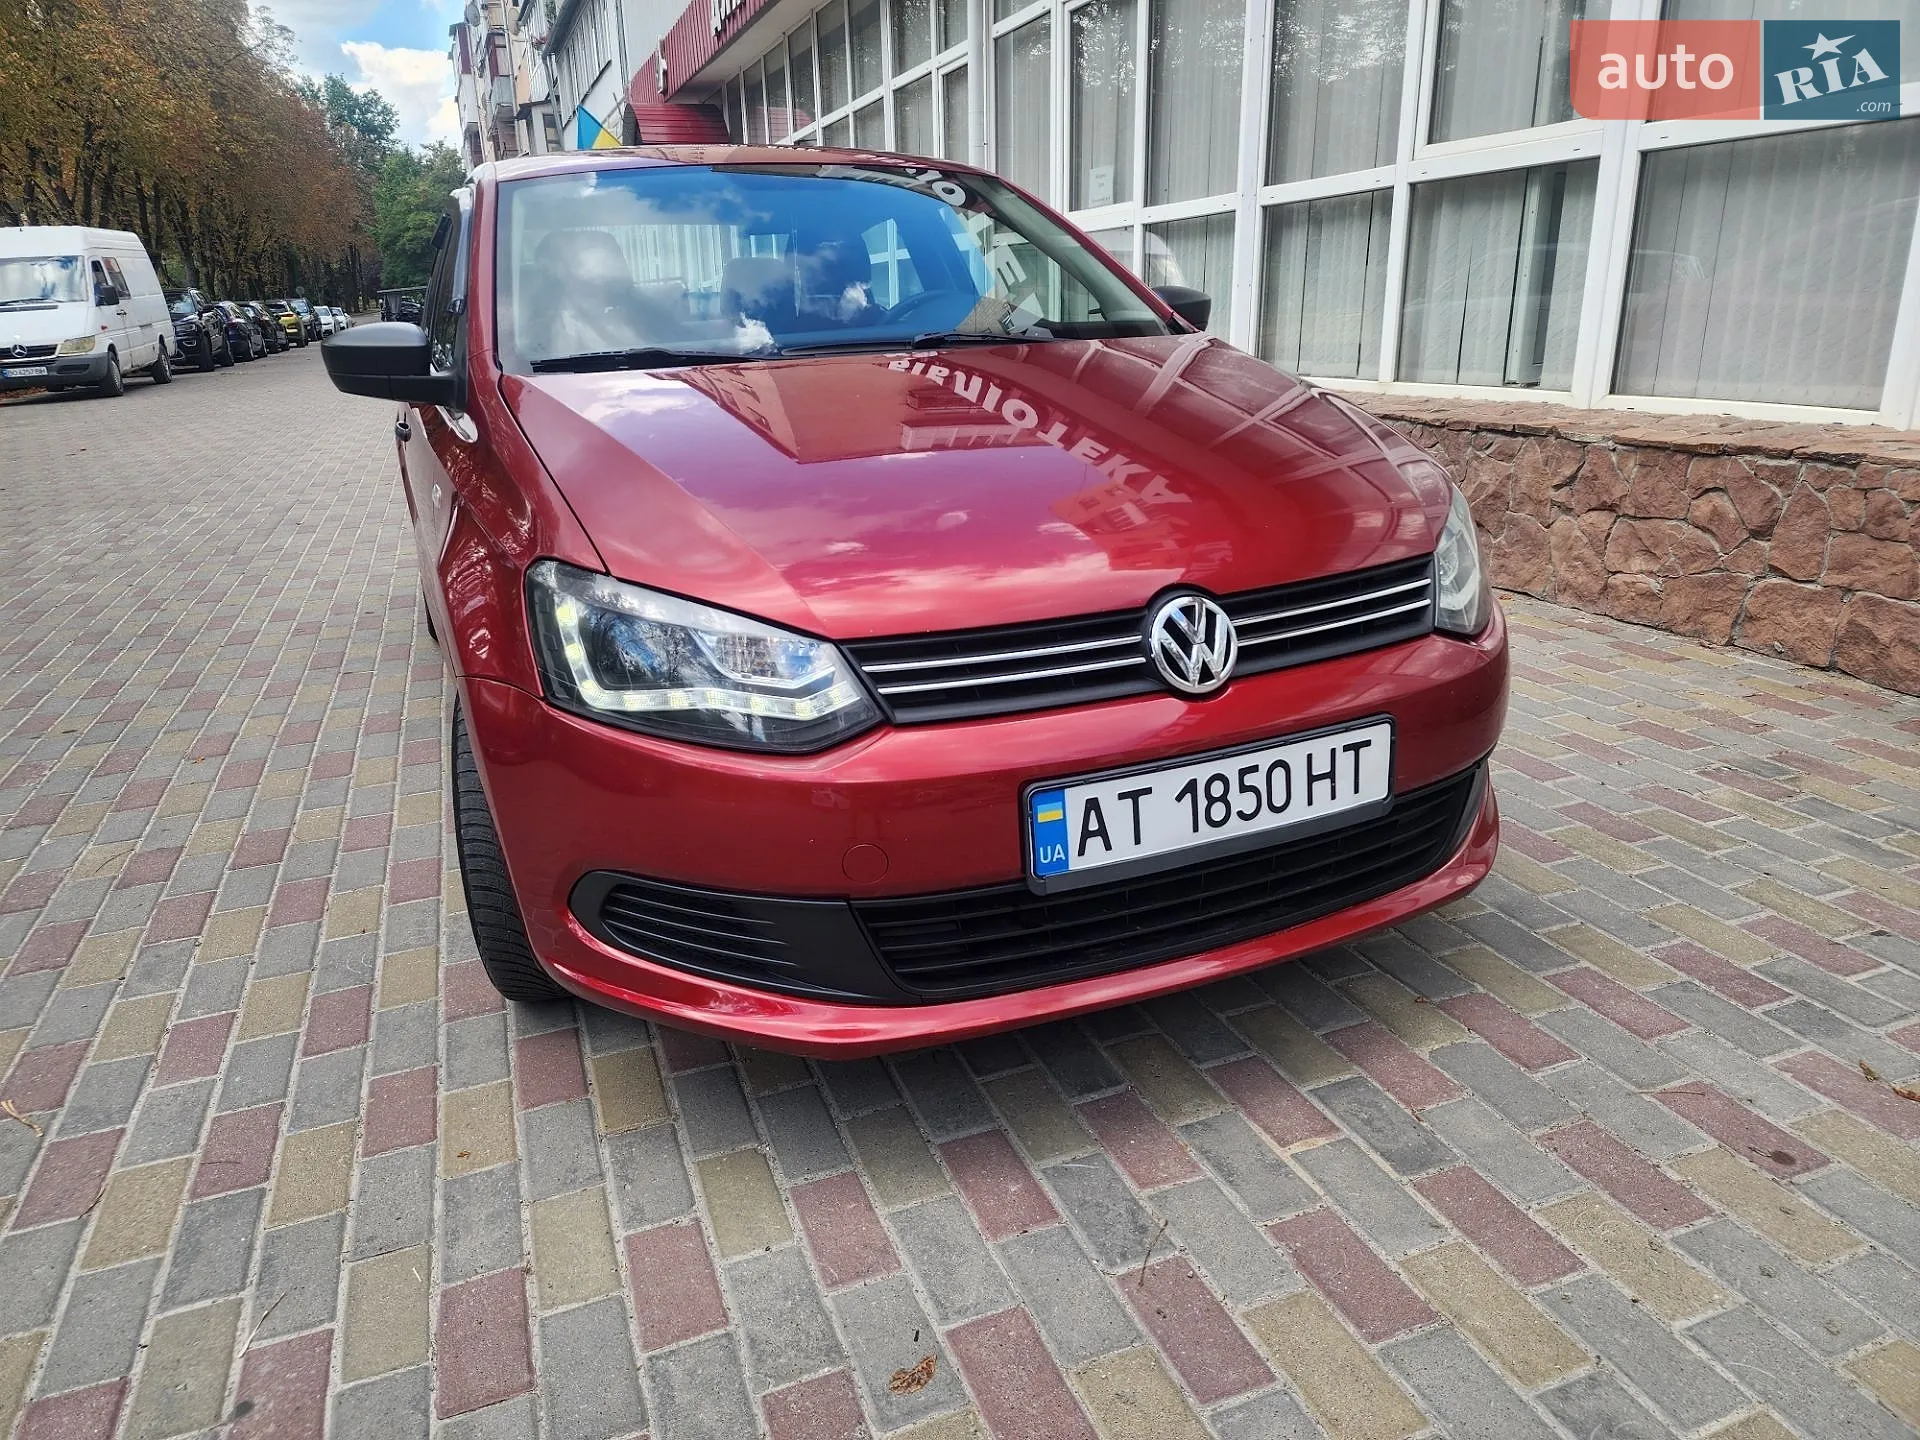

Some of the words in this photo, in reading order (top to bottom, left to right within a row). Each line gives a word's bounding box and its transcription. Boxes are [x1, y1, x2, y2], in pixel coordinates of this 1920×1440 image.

[1077, 786, 1153, 857] AT
[1174, 758, 1292, 833] 1850
[1306, 739, 1372, 807] HT
[1038, 842, 1066, 864] UA
